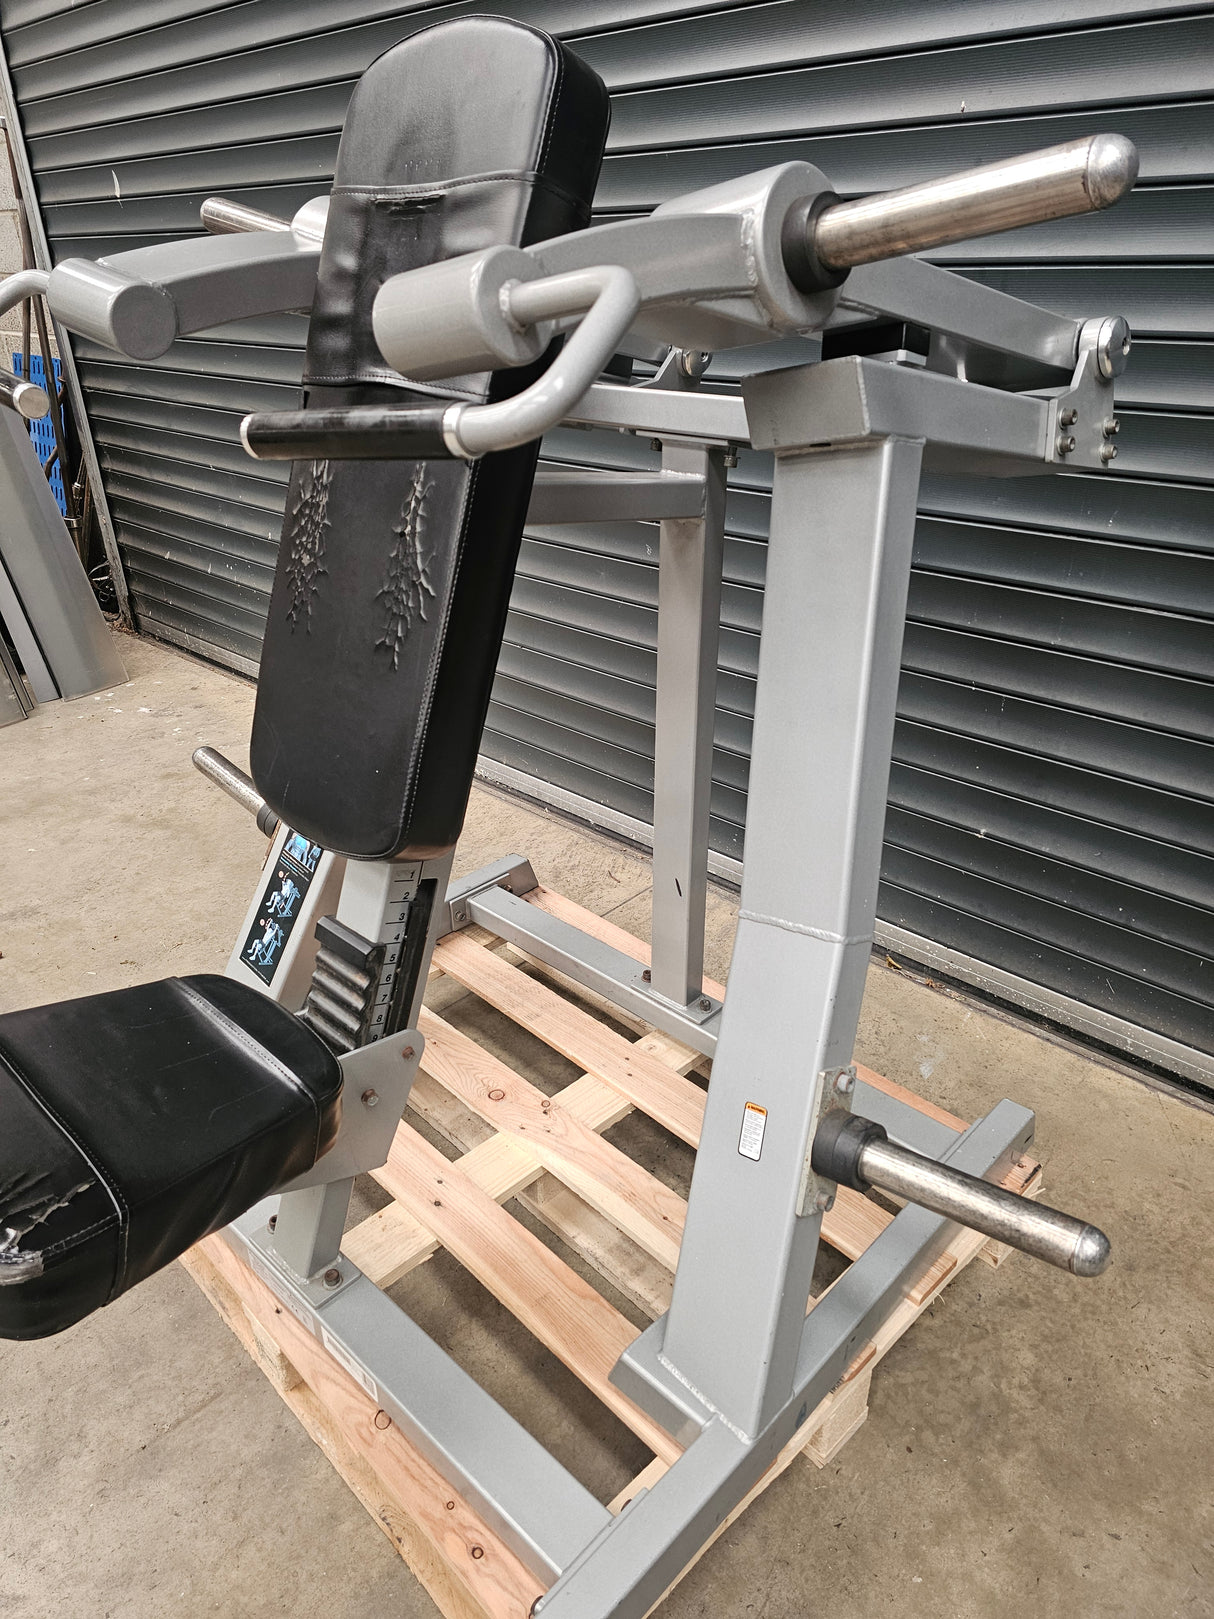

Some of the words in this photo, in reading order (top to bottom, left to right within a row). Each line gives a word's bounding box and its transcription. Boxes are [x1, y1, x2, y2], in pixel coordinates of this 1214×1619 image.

[403, 892, 410, 900] 2
[398, 912, 405, 921] 3
[394, 933, 401, 941] 4
[389, 954, 396, 962] 5
[385, 974, 392, 983] 6
[381, 994, 388, 1002] 7
[376, 1014, 383, 1023] 8
